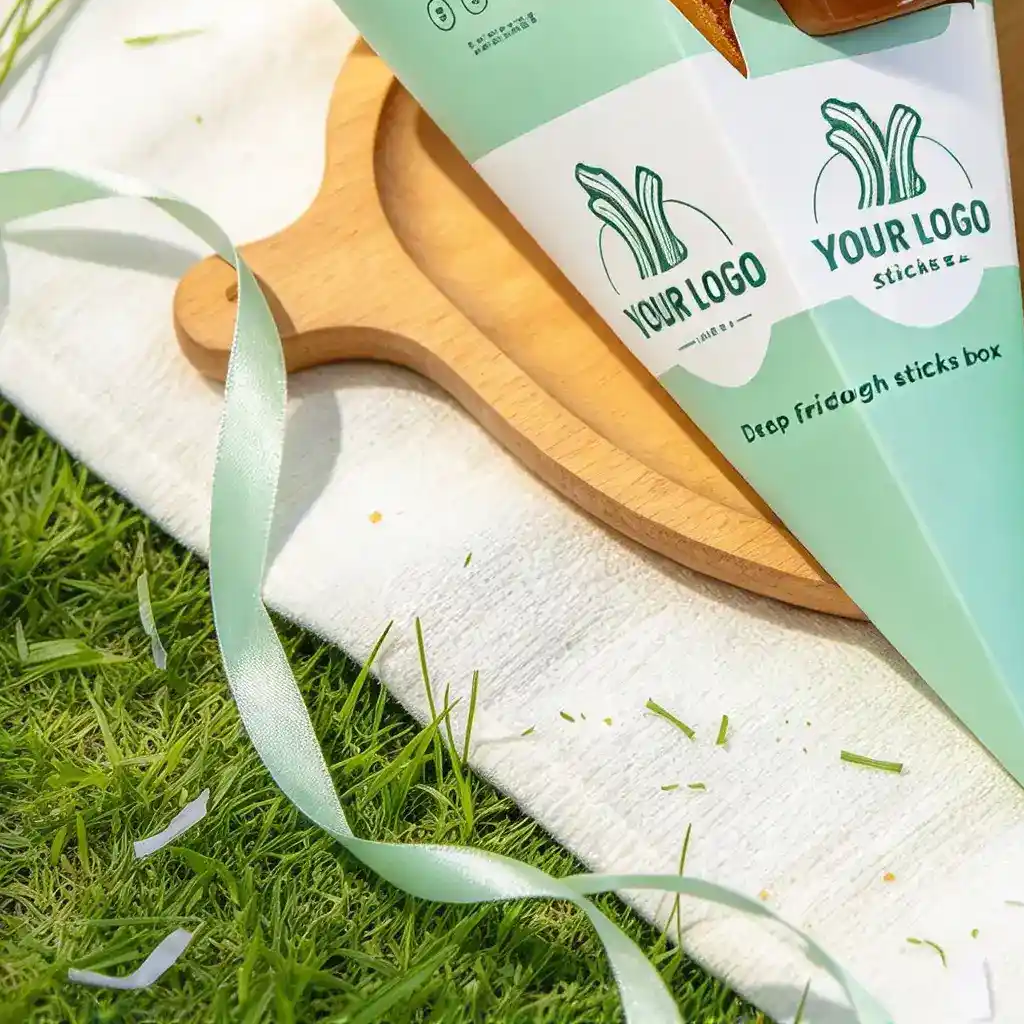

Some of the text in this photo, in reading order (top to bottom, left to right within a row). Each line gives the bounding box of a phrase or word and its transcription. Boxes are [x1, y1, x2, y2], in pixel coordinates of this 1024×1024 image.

[811, 199, 991, 271] YOUR LOGO
[623, 286, 692, 339] YOUR
[685, 251, 767, 311] LOGO
[894, 353, 960, 387] sticks
[962, 344, 1002, 367] box
